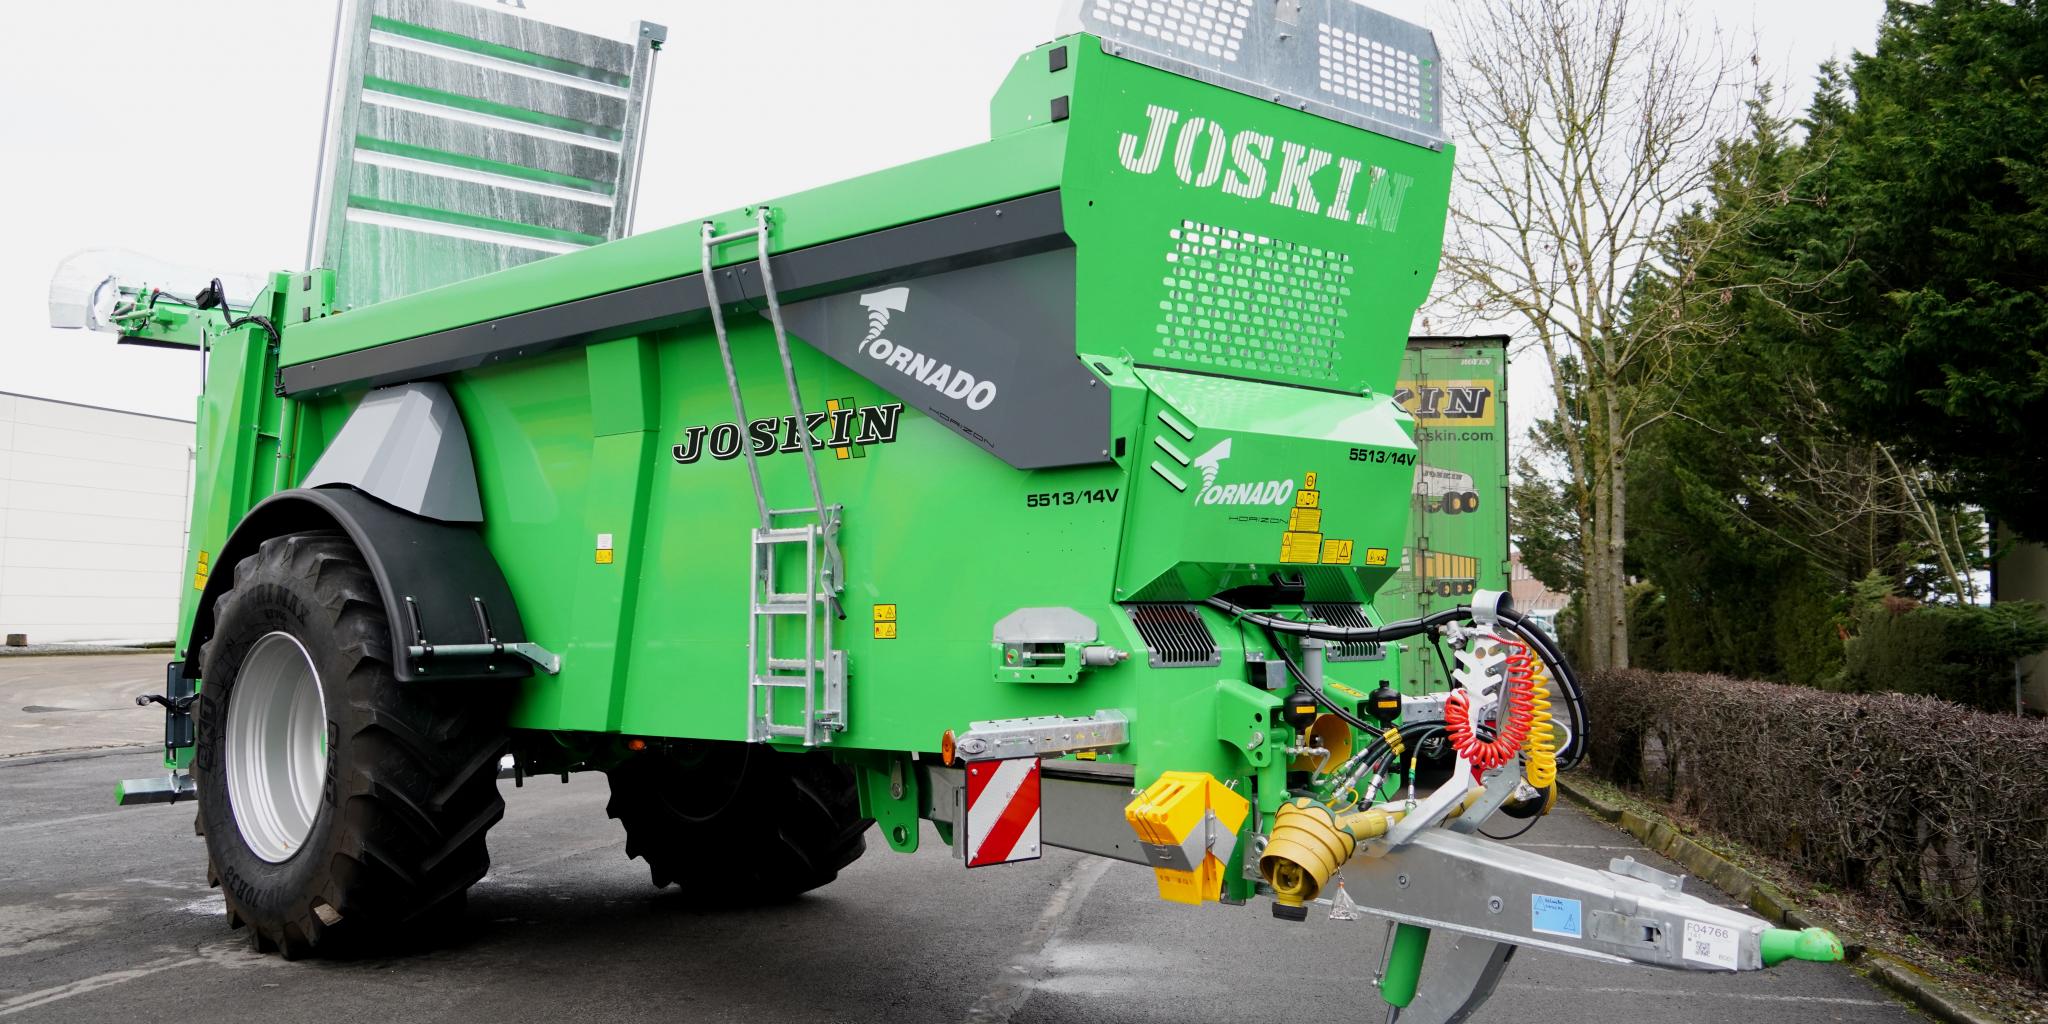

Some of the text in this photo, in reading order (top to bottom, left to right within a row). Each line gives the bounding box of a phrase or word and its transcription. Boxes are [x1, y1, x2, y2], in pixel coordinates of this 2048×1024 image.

[1118, 104, 1414, 232] JOSKIN
[858, 287, 997, 411] TORNADO
[1392, 387, 1491, 418] IN
[672, 402, 904, 465] JOSKIN
[1349, 448, 1416, 466] 5513/14V
[1193, 437, 1293, 506] TORNADO
[1026, 488, 1120, 508] 5513/14V
[1228, 515, 1289, 524] HORIZON
